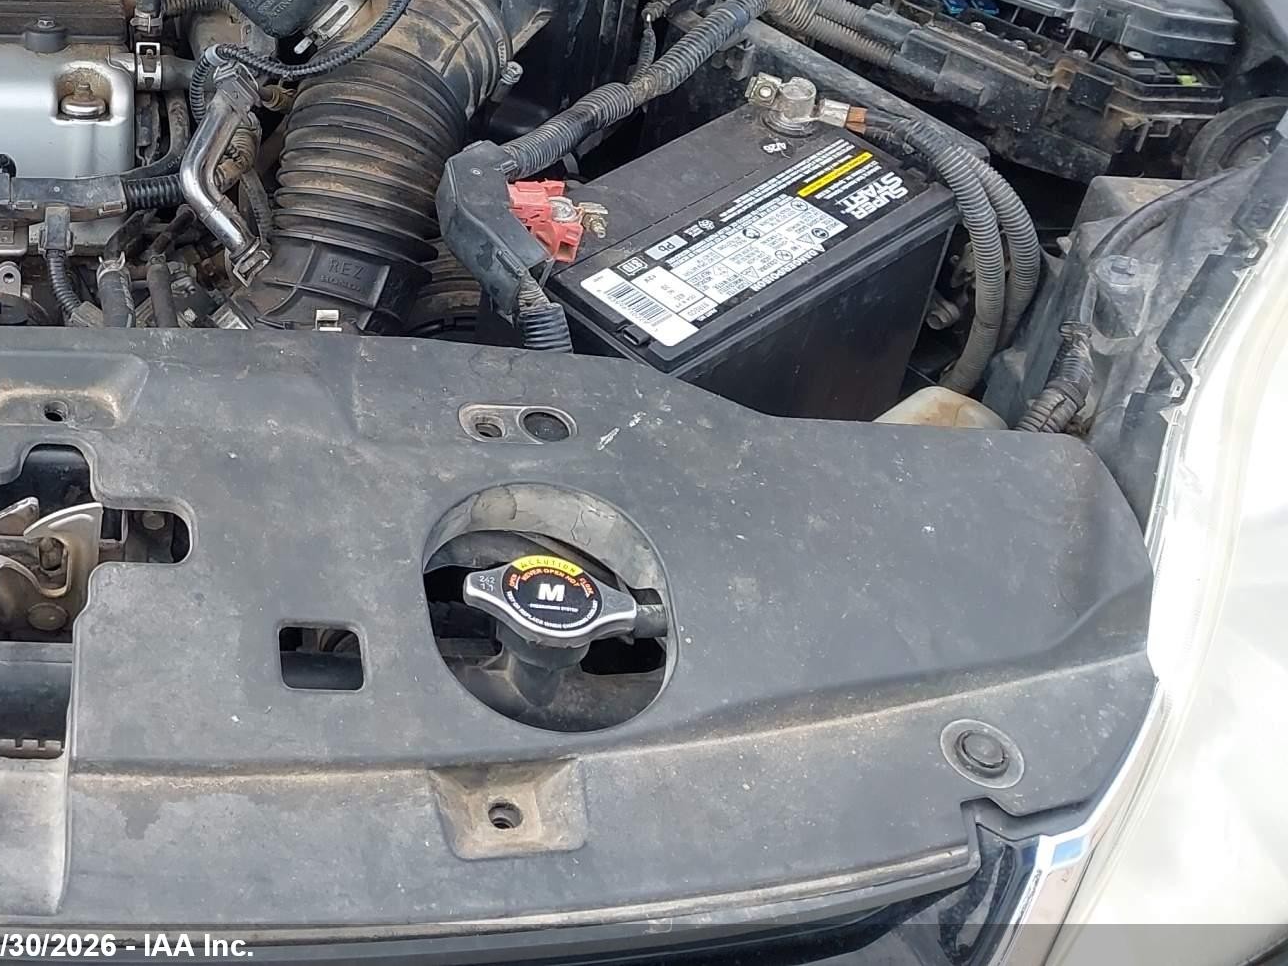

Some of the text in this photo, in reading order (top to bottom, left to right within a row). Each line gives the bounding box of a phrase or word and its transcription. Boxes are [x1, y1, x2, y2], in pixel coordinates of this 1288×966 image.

[842, 172, 903, 213] START
[850, 187, 910, 220] SUPER
[657, 242, 676, 252] Pb
[528, 558, 577, 573] CAUTION
[543, 568, 564, 578] OPEN
[538, 583, 565, 602] M
